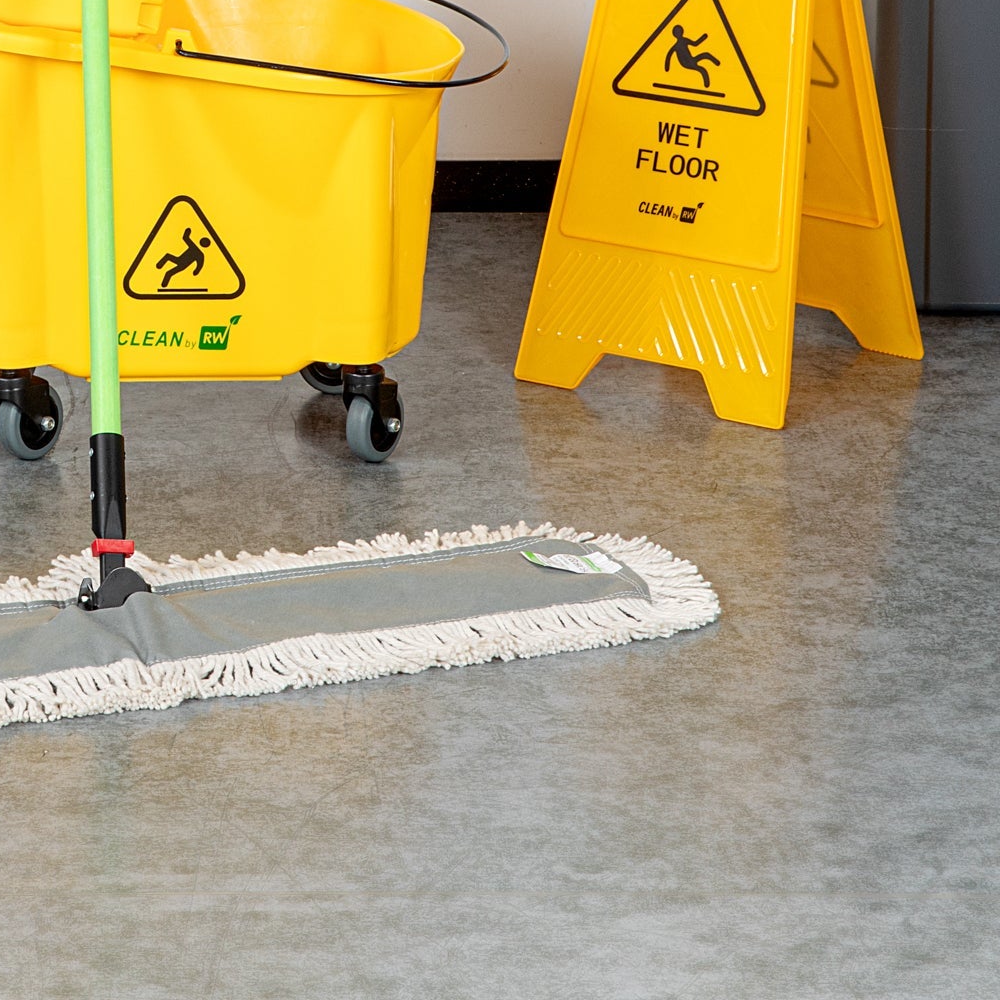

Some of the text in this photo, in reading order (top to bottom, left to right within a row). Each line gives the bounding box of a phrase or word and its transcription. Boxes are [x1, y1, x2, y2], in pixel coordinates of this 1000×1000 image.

[658, 121, 709, 149] WET
[635, 148, 719, 182] FLOOR
[638, 201, 673, 218] CLEAN
[118, 330, 184, 347] CLEAN
[185, 340, 197, 349] by
